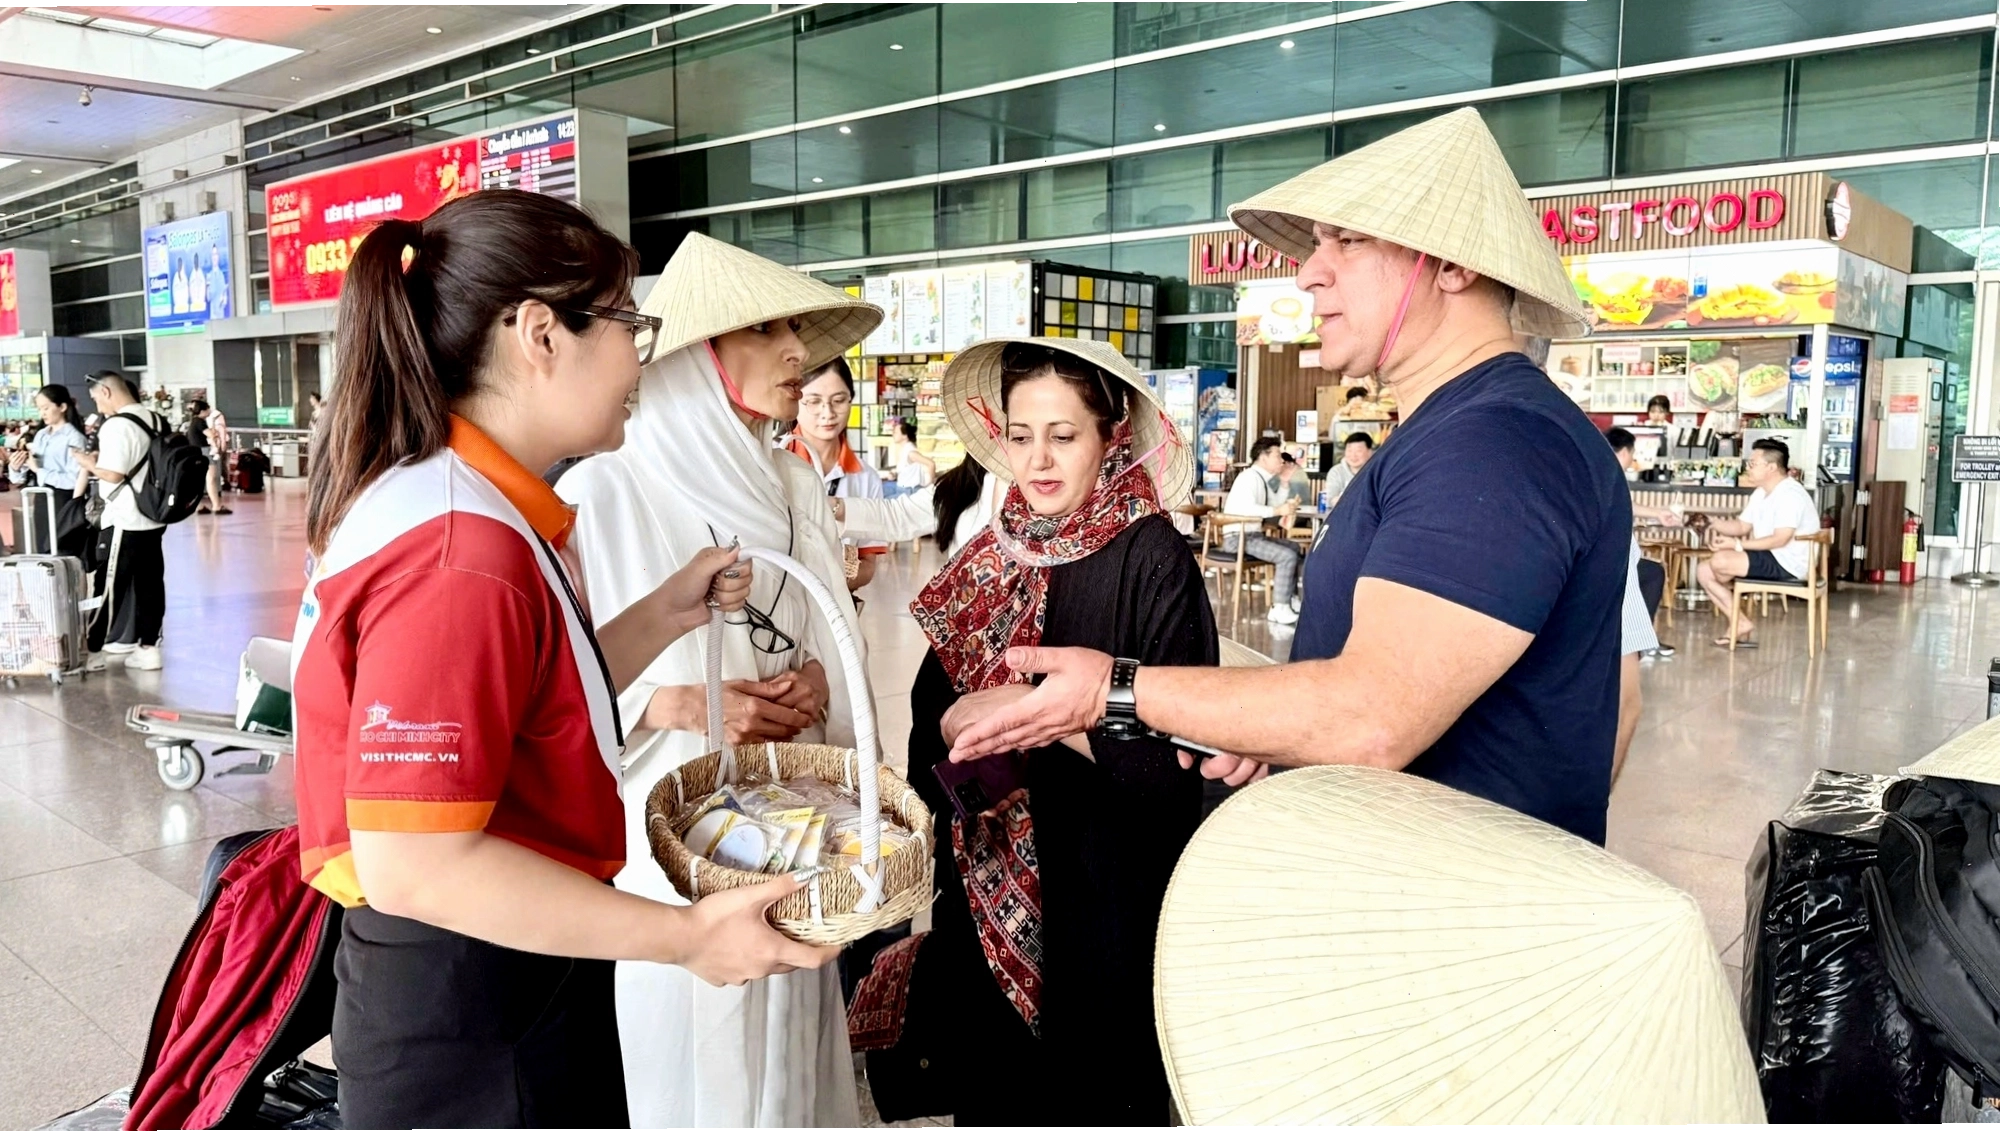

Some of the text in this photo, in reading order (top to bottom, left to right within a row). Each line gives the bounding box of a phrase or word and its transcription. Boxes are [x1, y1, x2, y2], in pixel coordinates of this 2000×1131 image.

[383, 192, 402, 212] CÁO
[1541, 189, 1785, 245] ASTFOOD
[1825, 360, 1855, 375] epsi
[1972, 463, 1995, 471] TROLLEY
[1956, 471, 1987, 479] EMERGENCY
[360, 731, 461, 743] HO CHI MINH CITY
